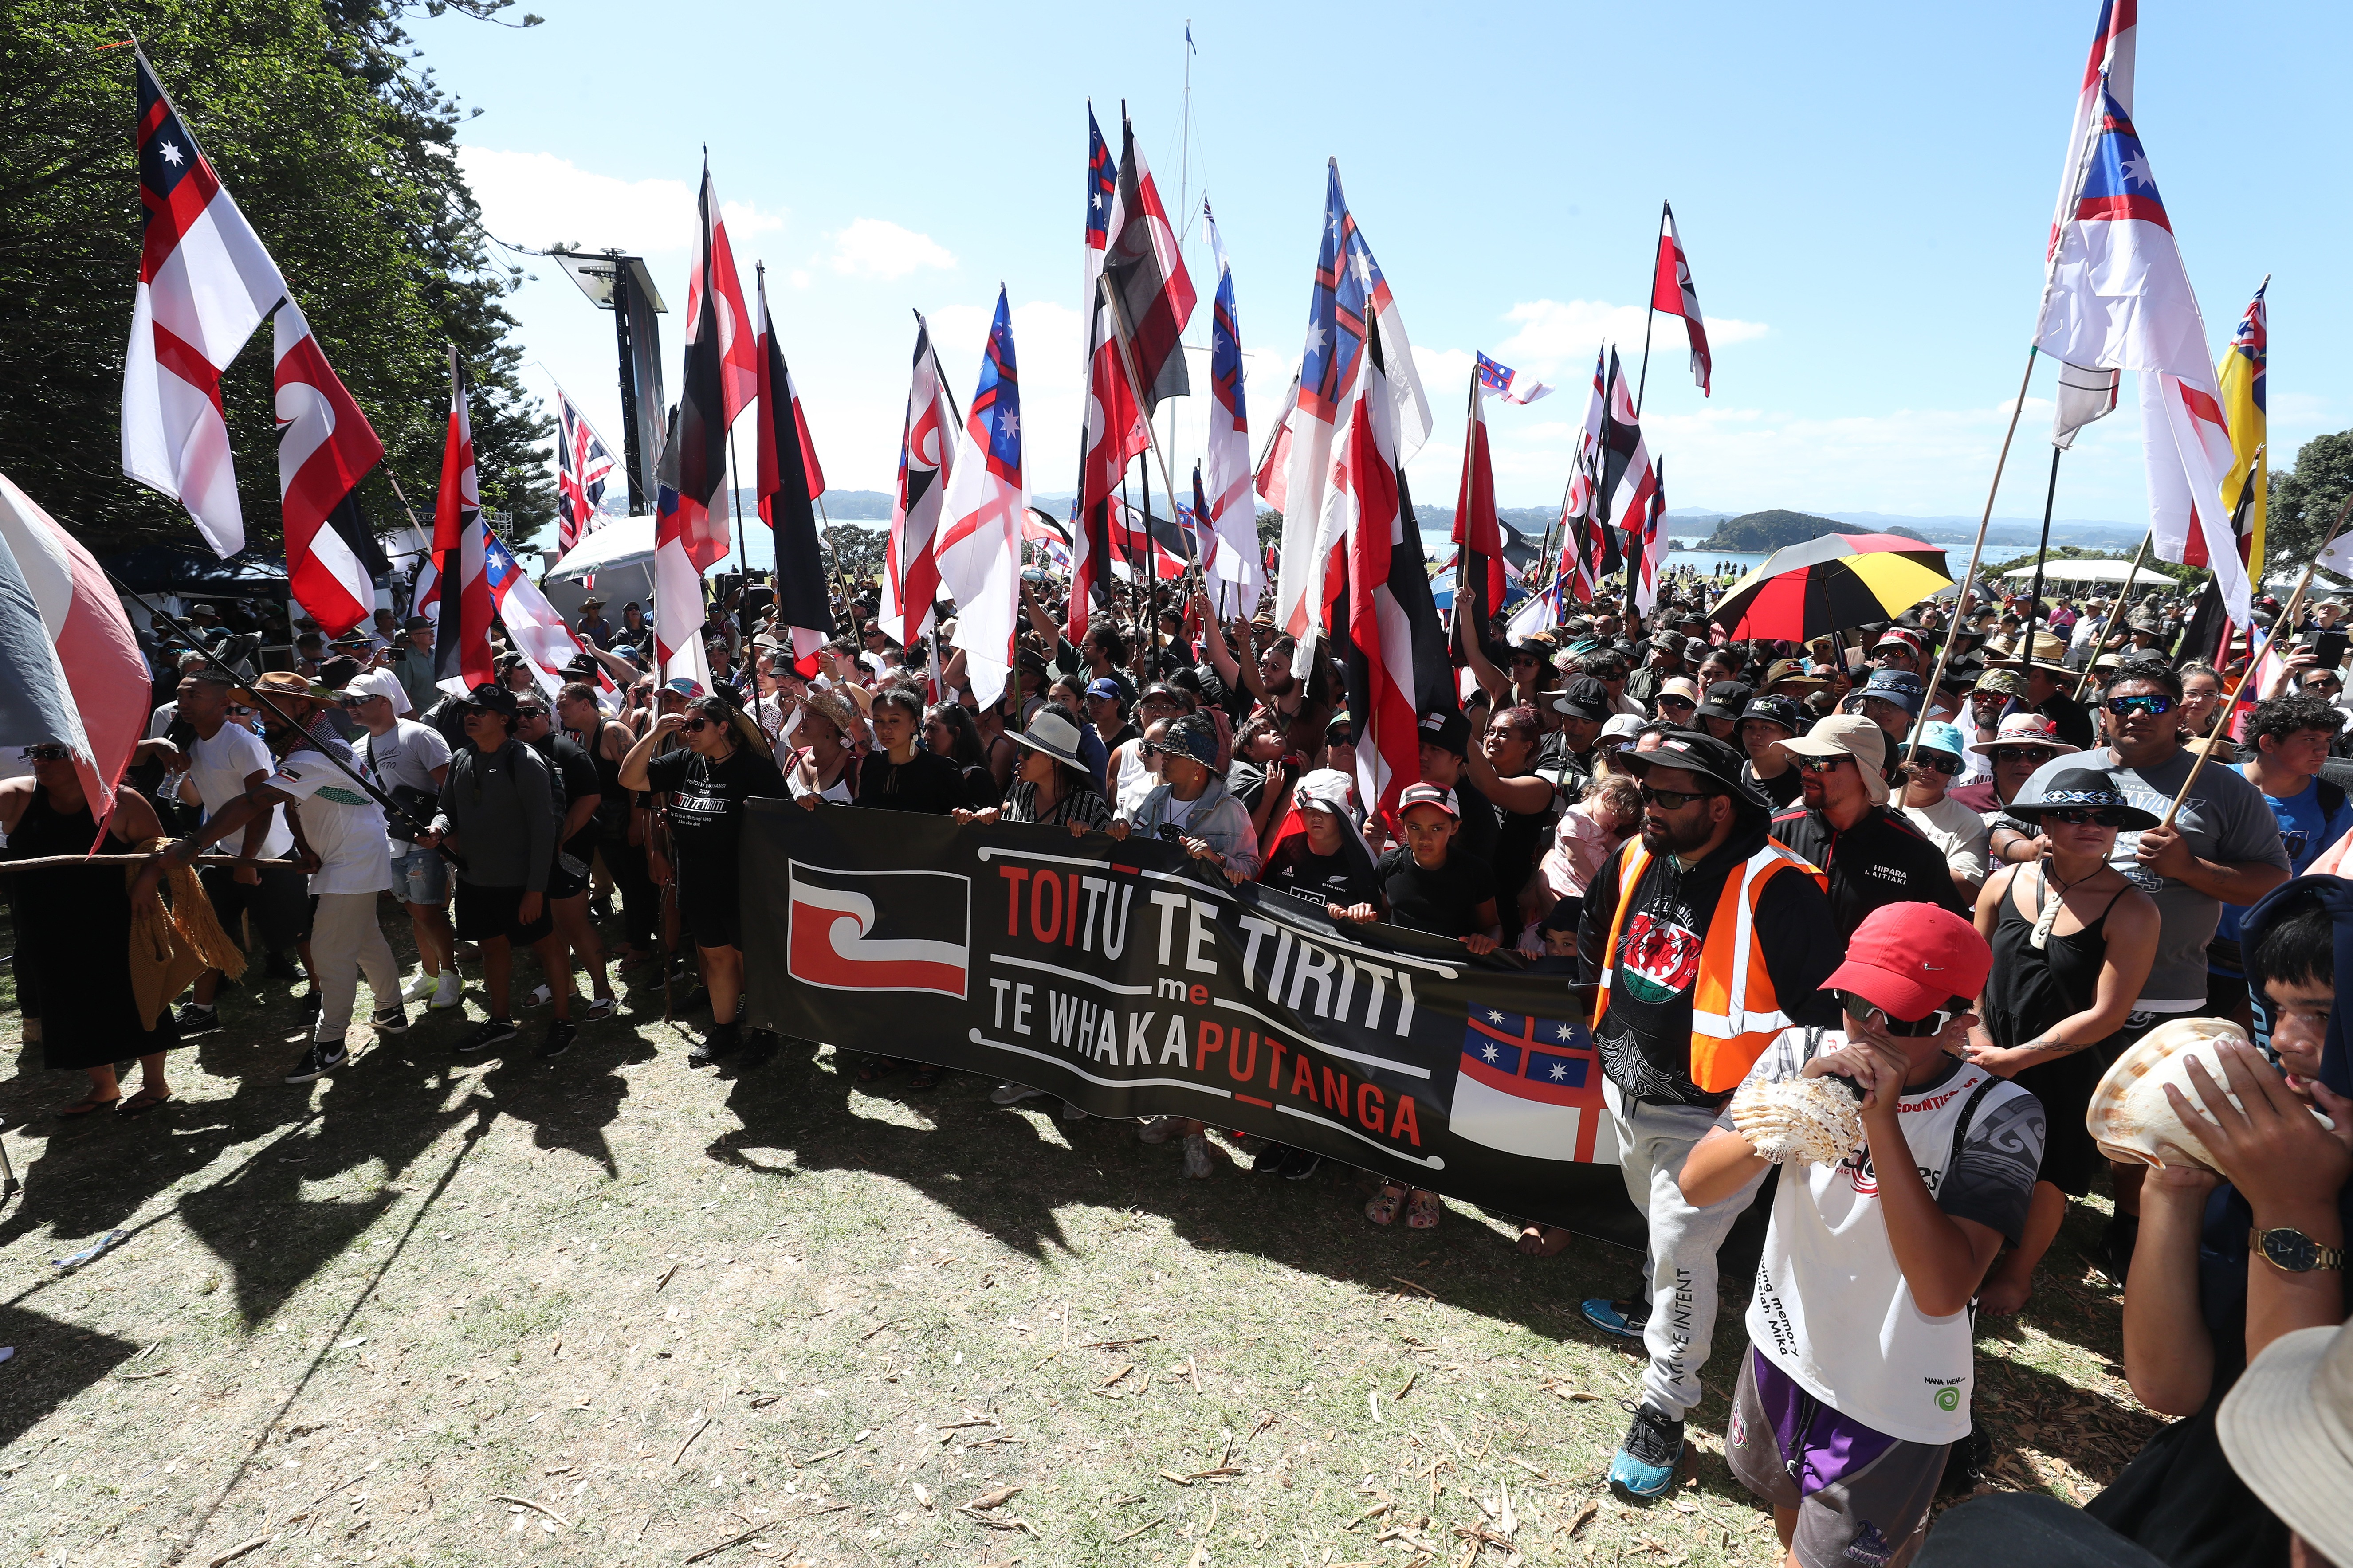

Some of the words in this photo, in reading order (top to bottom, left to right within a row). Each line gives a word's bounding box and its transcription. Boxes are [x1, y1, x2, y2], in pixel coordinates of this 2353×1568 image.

[1136, 576, 1148, 584] IRIT
[379, 761, 397, 770] 1970
[691, 800, 703, 809] TE
[701, 800, 725, 811] TIRITI
[1150, 890, 1219, 975] TE
[1239, 914, 1416, 1038] TIRITI
[1158, 977, 1208, 1005] me
[990, 978, 1033, 1035] TE
[1049, 989, 1421, 1147] WHAKAPUTANGA
[1673, 1268, 1693, 1330] INTENT
[1760, 1254, 1773, 1292] oving
[1772, 1297, 1799, 1358] memory
[1768, 1320, 1788, 1356] Mika
[1924, 1376, 1944, 1385] MANA
[1946, 1377, 1960, 1385] WEAR
